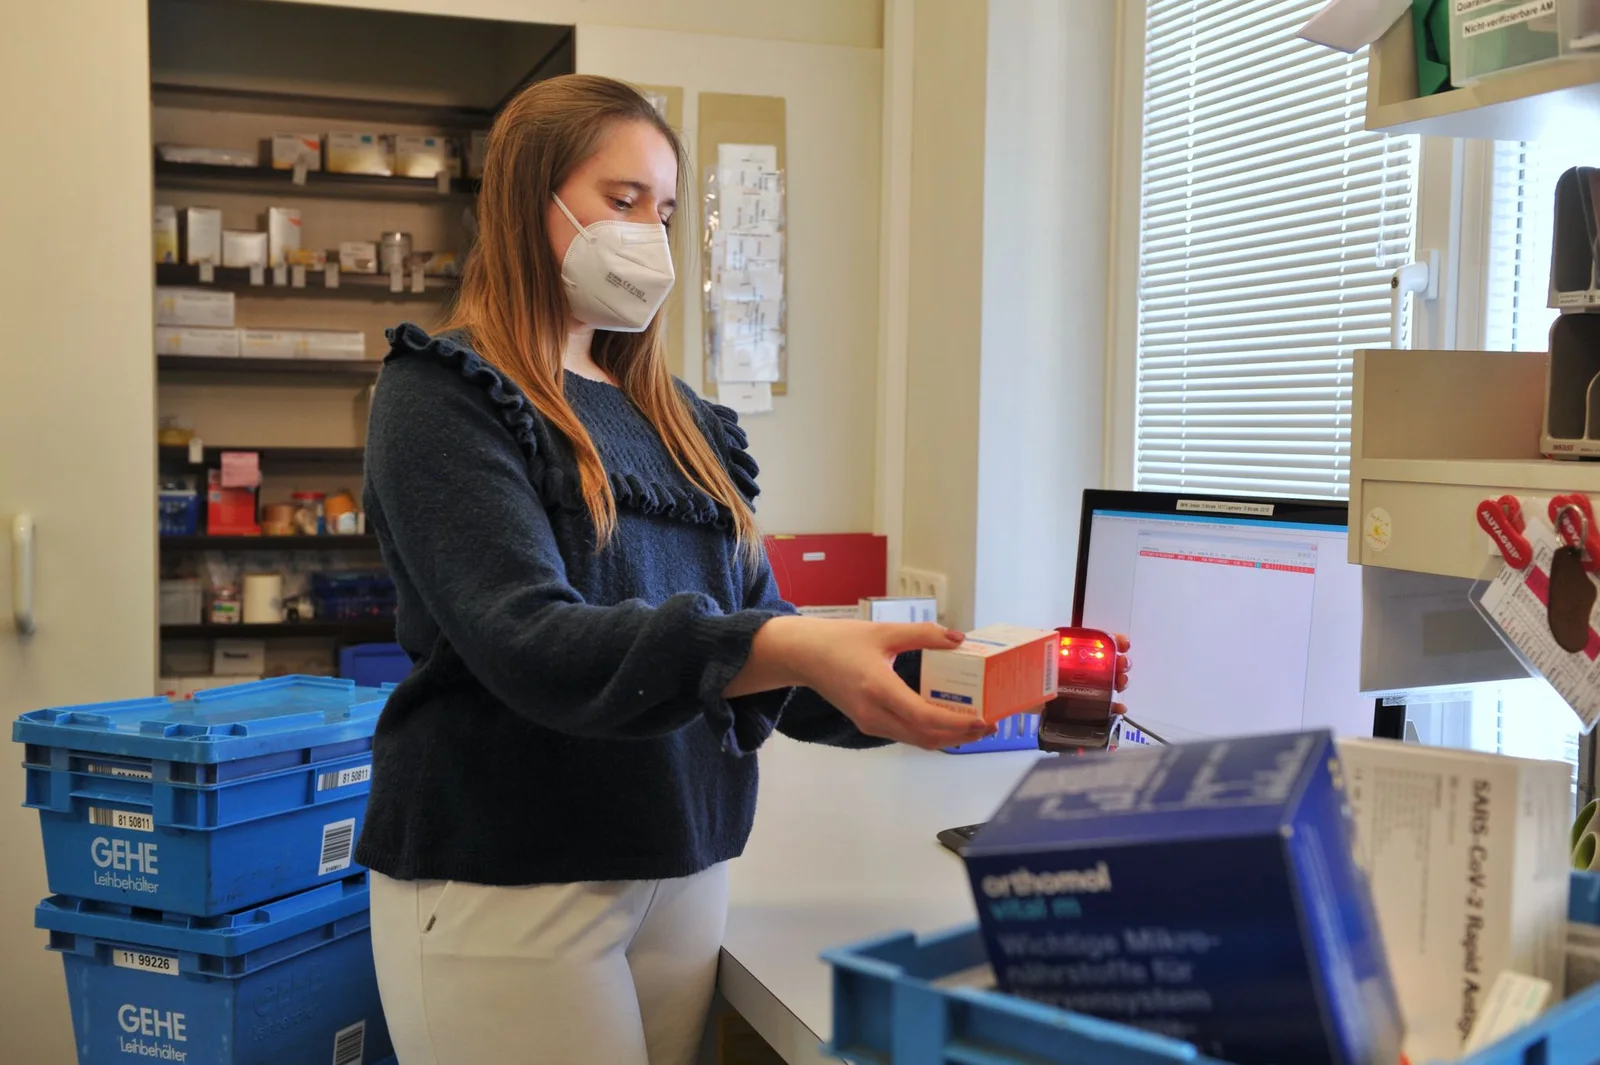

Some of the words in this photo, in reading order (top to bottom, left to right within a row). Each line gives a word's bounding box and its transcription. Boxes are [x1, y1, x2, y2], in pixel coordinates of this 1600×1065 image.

[1465, 7, 1538, 34] Nicht-verifizierbare
[1540, 2, 1554, 13] AM
[118, 814, 127, 826] 81
[128, 815, 150, 829] 50811
[91, 836, 158, 875] GEHE
[1465, 778, 1491, 908] SARS-CoV-2
[94, 870, 159, 893] Leihbehälter
[982, 860, 1112, 898] orthomol
[124, 952, 134, 964] 11
[138, 954, 170, 970] 99226
[1460, 914, 1485, 974] Rapid
[118, 1003, 187, 1042] GEHE
[120, 1035, 188, 1062] Leihbehälter
